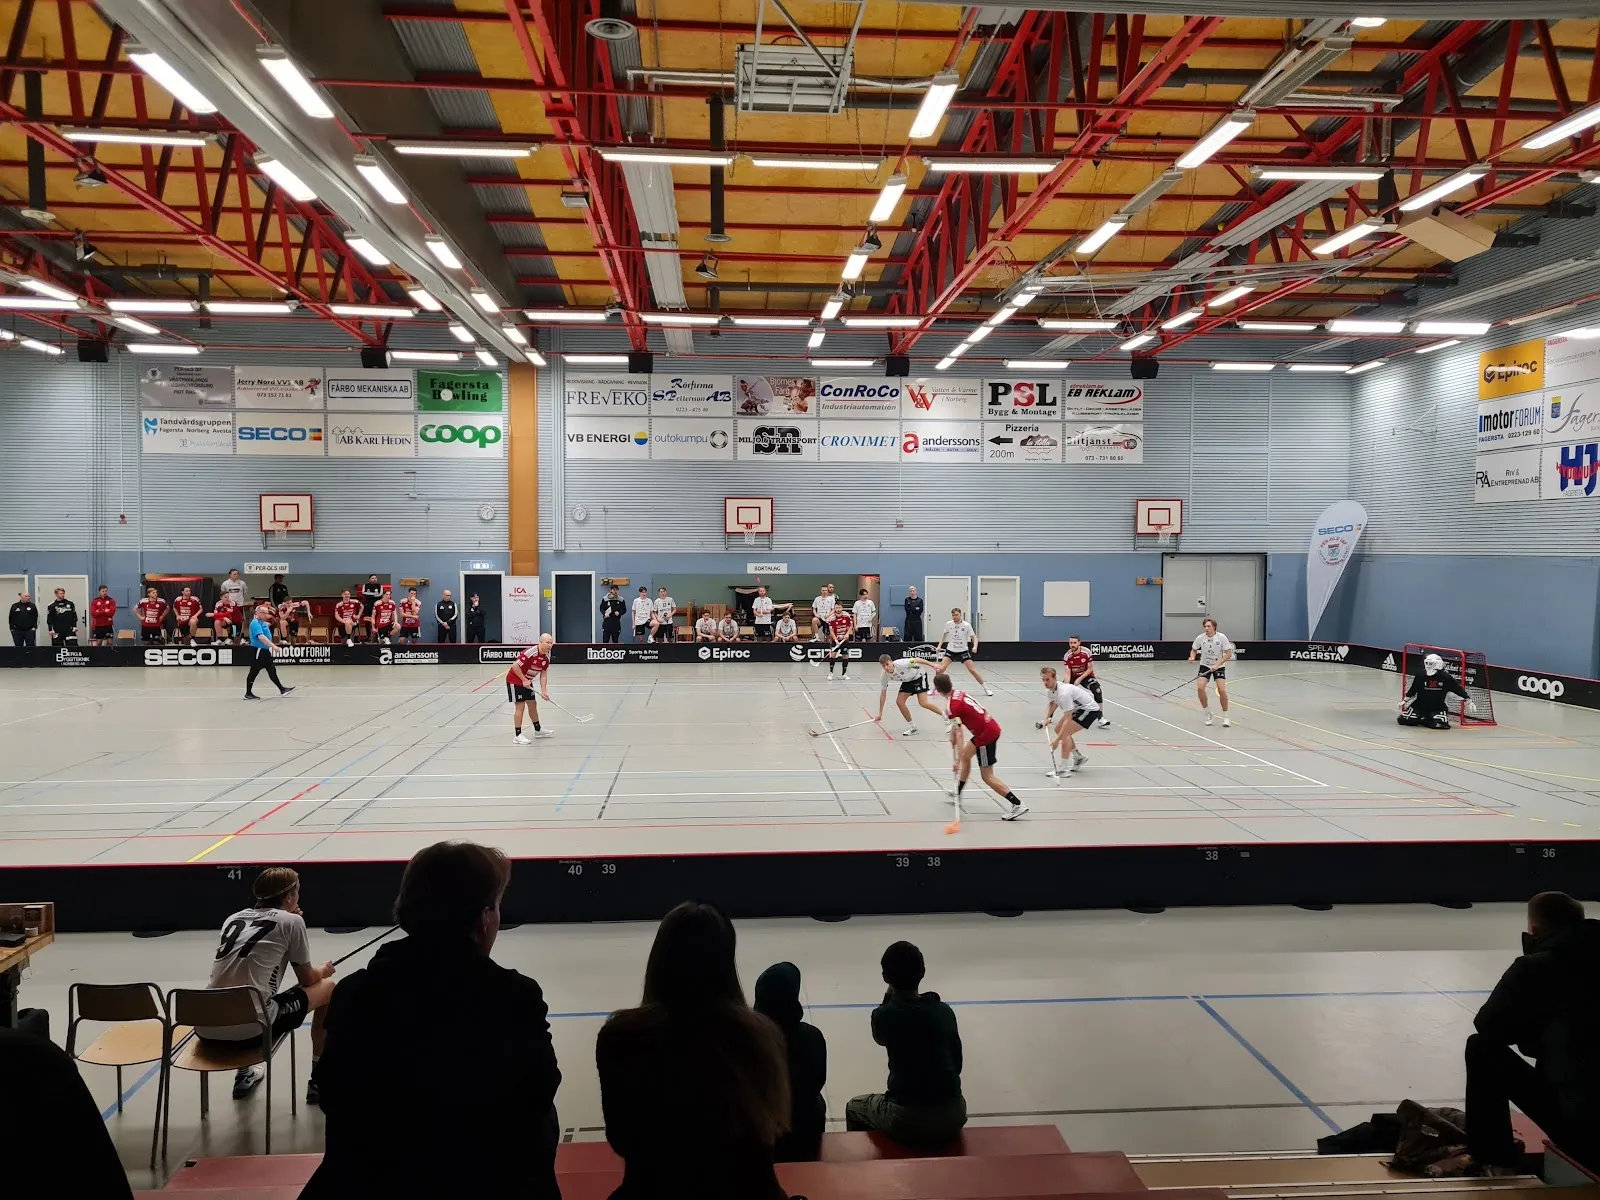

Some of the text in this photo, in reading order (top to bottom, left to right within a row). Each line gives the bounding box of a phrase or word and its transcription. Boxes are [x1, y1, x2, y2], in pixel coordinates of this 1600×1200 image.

[1498, 361, 1538, 382] Epiroc
[331, 383, 356, 393] FÅRBO
[357, 385, 399, 393] MEKANISKA
[430, 378, 489, 390] Fagersta
[671, 378, 714, 390] Rörfirma
[706, 391, 731, 402] AB
[821, 384, 900, 398] ConRoCo
[988, 382, 1058, 407] PSL
[1067, 388, 1136, 398] EB REKLAM
[822, 403, 897, 411] Industriautomation
[988, 408, 1010, 417] Bygg
[1021, 409, 1057, 417] Montage
[160, 418, 232, 427] Tandvårdsgruppen
[1006, 424, 1039, 432] Pizzeria
[238, 426, 307, 441] SECO
[567, 433, 631, 443] VB ENERGI
[655, 433, 708, 444] outokumpu
[1479, 435, 1505, 443] FAGERSTA
[340, 435, 354, 445] AB
[821, 436, 899, 447] CRONIMET
[922, 436, 981, 446] anderssons
[990, 449, 1015, 459] 200m
[1491, 475, 1539, 487] ENTREPRENAD AB
[1318, 525, 1354, 536] SECO
[587, 647, 627, 660] indoor
[1101, 644, 1155, 654] MARCEGAGLIA
[1308, 644, 1333, 652] SPELA
[145, 648, 217, 666] SECO
[394, 650, 439, 659] anderssons
[483, 650, 503, 658] FÅRBO
[712, 647, 751, 661] Epiroc
[1518, 675, 1565, 700] coop
[1205, 850, 1219, 861] 38
[1542, 848, 1556, 859] 36
[896, 856, 941, 867] 39 38
[228, 869, 242, 880] 41
[568, 863, 617, 875] 40 39
[215, 919, 278, 960] 97
